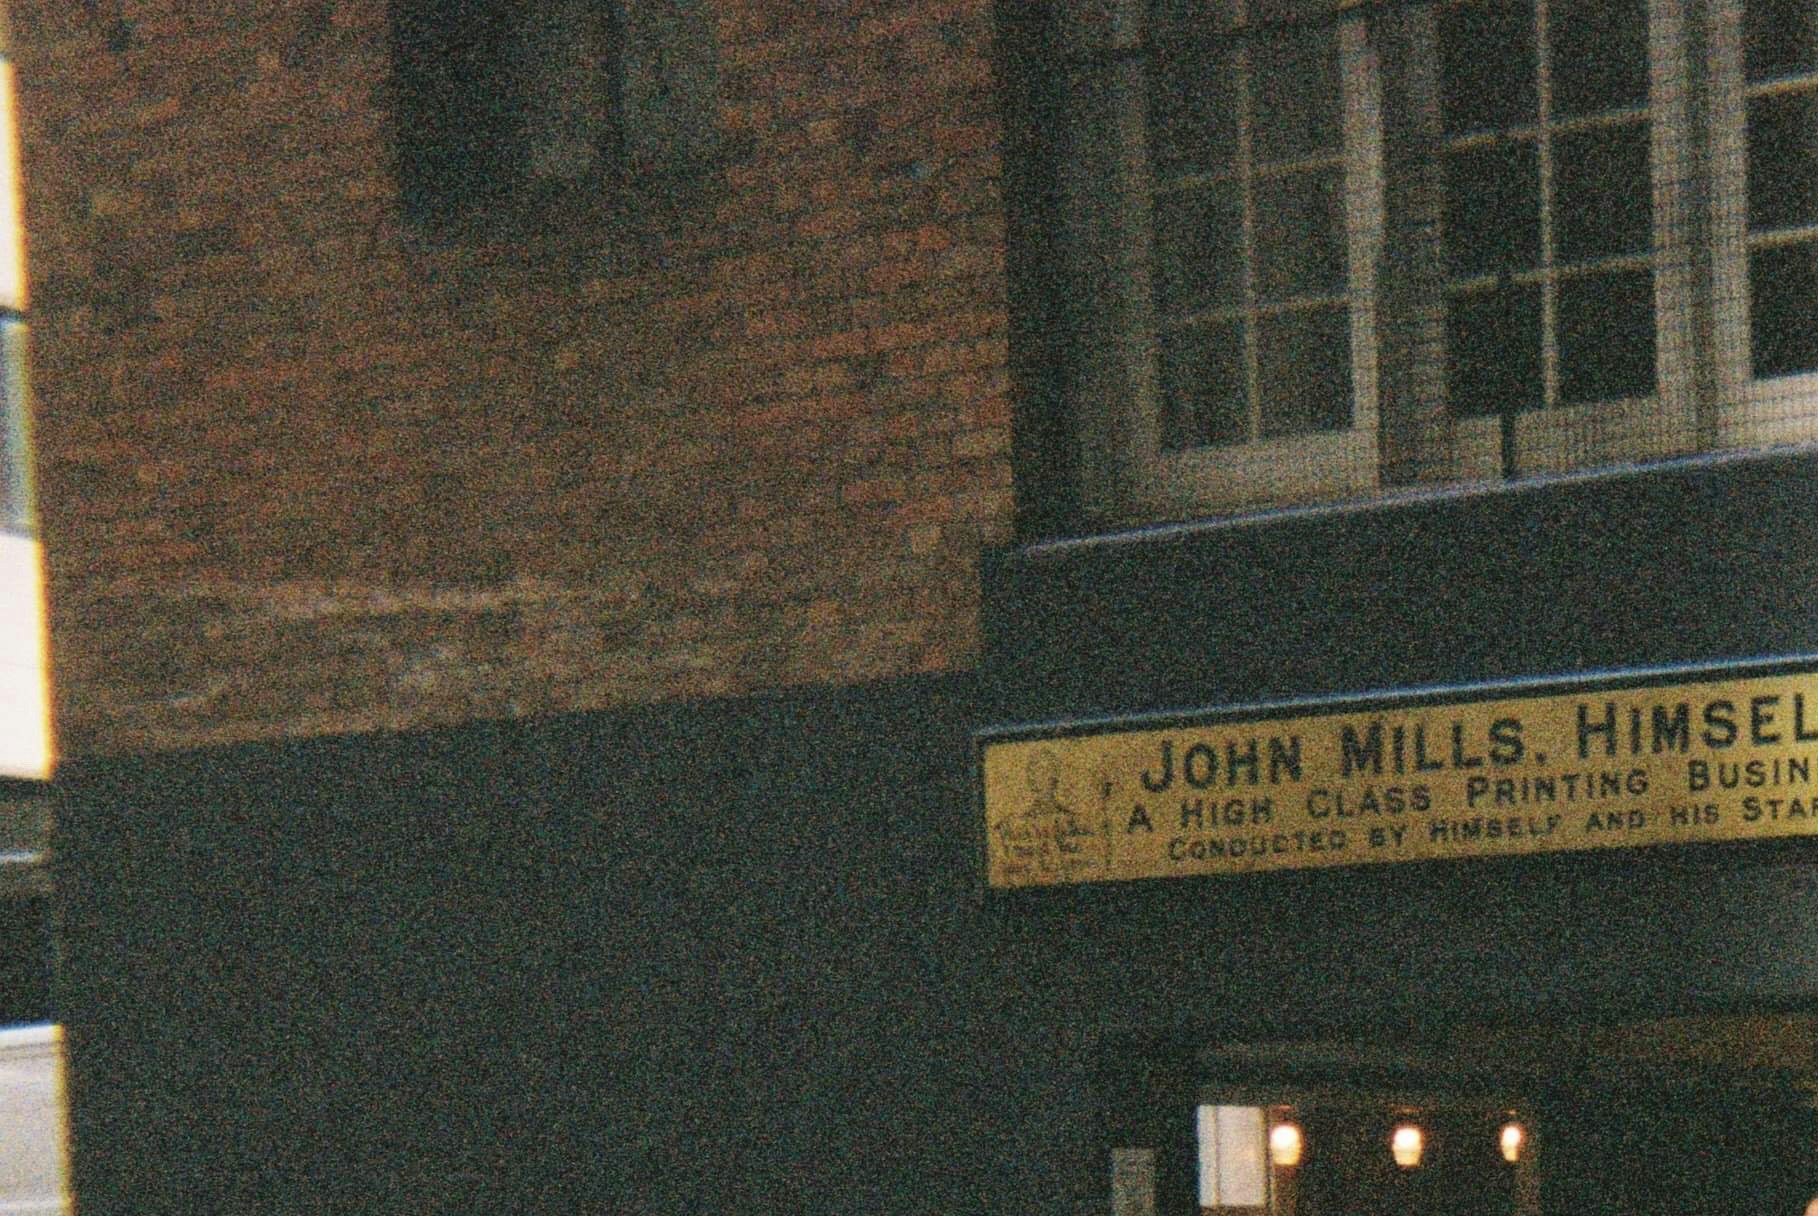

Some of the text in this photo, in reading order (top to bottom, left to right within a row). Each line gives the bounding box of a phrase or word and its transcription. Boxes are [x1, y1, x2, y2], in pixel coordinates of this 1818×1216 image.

[1141, 735, 1302, 793] JOHN
[1127, 803, 1152, 834] A
[1181, 797, 1272, 829] HIGH
[1307, 783, 1430, 819] CLASS
[1467, 767, 1648, 807] PRINTING
[1168, 829, 1346, 861] CONDUCTED
[1369, 823, 1406, 848] BY
[1430, 813, 1561, 843] HIMSELF
[1586, 808, 1646, 833] AND
[1670, 803, 1720, 826] HIS
